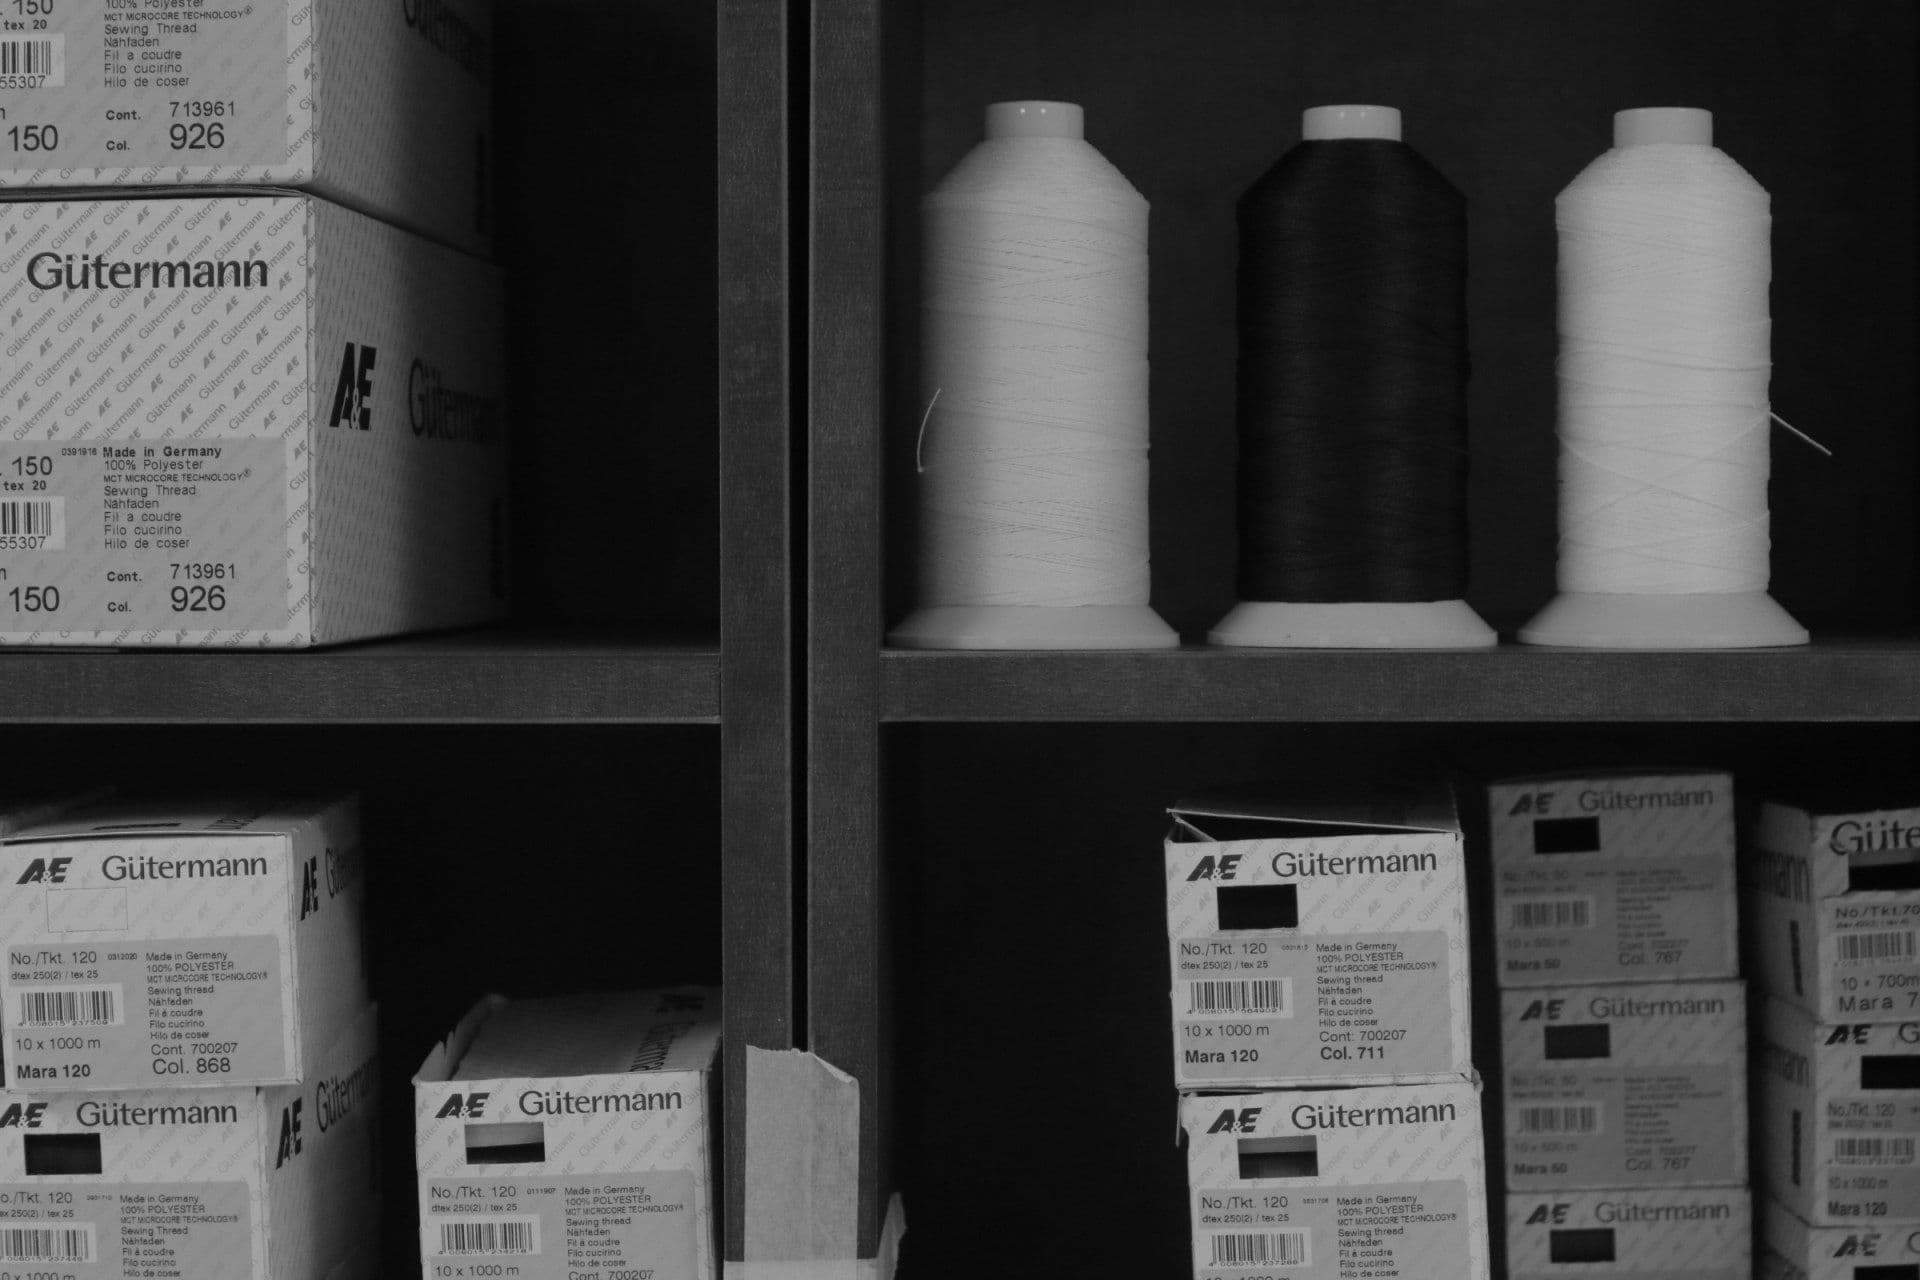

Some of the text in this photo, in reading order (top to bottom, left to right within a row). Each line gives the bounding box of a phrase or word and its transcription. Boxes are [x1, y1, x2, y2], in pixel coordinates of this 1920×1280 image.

[4, 20, 47, 30] tex 20
[105, 23, 197, 36] Sewing Thread
[105, 50, 119, 61] Fil
[141, 51, 182, 61] coudre
[105, 63, 182, 74] Filo cucirino
[105, 76, 190, 88] Hilo de coser
[106, 102, 236, 121] Cont. 713961
[7, 124, 59, 152] 150
[106, 123, 225, 151] Col. 926
[26, 251, 269, 290] Gütermann
[102, 446, 137, 458] Made
[144, 446, 155, 457] in
[163, 445, 222, 459] Germany
[12, 456, 53, 476] 150
[104, 459, 204, 472] 100% Polyester
[104, 474, 122, 483] MCT
[125, 473, 179, 483] MICROCORE
[3, 480, 47, 491] tex 20
[104, 484, 196, 498] Sewing Thread
[104, 511, 119, 522] Fil
[141, 511, 182, 522] coudre
[104, 524, 182, 535] Filo cucirino
[104, 538, 190, 549] Hilo de coser
[106, 564, 236, 583] Cont. 713961
[9, 586, 60, 612] 150
[107, 585, 226, 613] Col. 926
[1579, 789, 1714, 812] Gütermann
[102, 854, 268, 881] Gütermann
[1271, 851, 1437, 877] Gütermann
[1242, 942, 1268, 955] 120
[1316, 942, 1398, 953] Made in Germany
[72, 951, 97, 964] 120
[145, 951, 228, 962] Made in Germany
[1316, 952, 1404, 963] 100% POLYESTER
[146, 962, 234, 973] 100% POLYESTER
[1181, 960, 1269, 971] dtex 250(2) tex 25
[11, 970, 99, 981] dtex 250(2) tex 25
[1316, 974, 1384, 985] Sewing thread
[147, 985, 214, 996] Sewing thread
[170, 1008, 203, 1017] coudre
[1589, 997, 1725, 1019] Gütermann
[149, 1019, 205, 1029] Filo cucirino
[1184, 1024, 1270, 1037] 10 x 1000 m
[150, 1031, 210, 1040] Hilo de coser
[1359, 1030, 1407, 1041] 700207
[16, 1037, 101, 1050] 10 x 1000 m
[151, 1042, 238, 1056] Cont. 700207
[1185, 1049, 1259, 1063] Mara 120
[1320, 1045, 1385, 1060] Col. 711
[17, 1064, 91, 1079] Mara 120
[152, 1057, 232, 1075] Col. 868
[518, 1089, 682, 1116] Gütermann
[76, 1101, 238, 1127] Gütermann
[1291, 1102, 1456, 1130] Gütermann
[48, 1191, 73, 1204] 120
[492, 1185, 517, 1198] 120
[1263, 1196, 1289, 1208] 120
[1594, 1201, 1730, 1223] Gütermann
